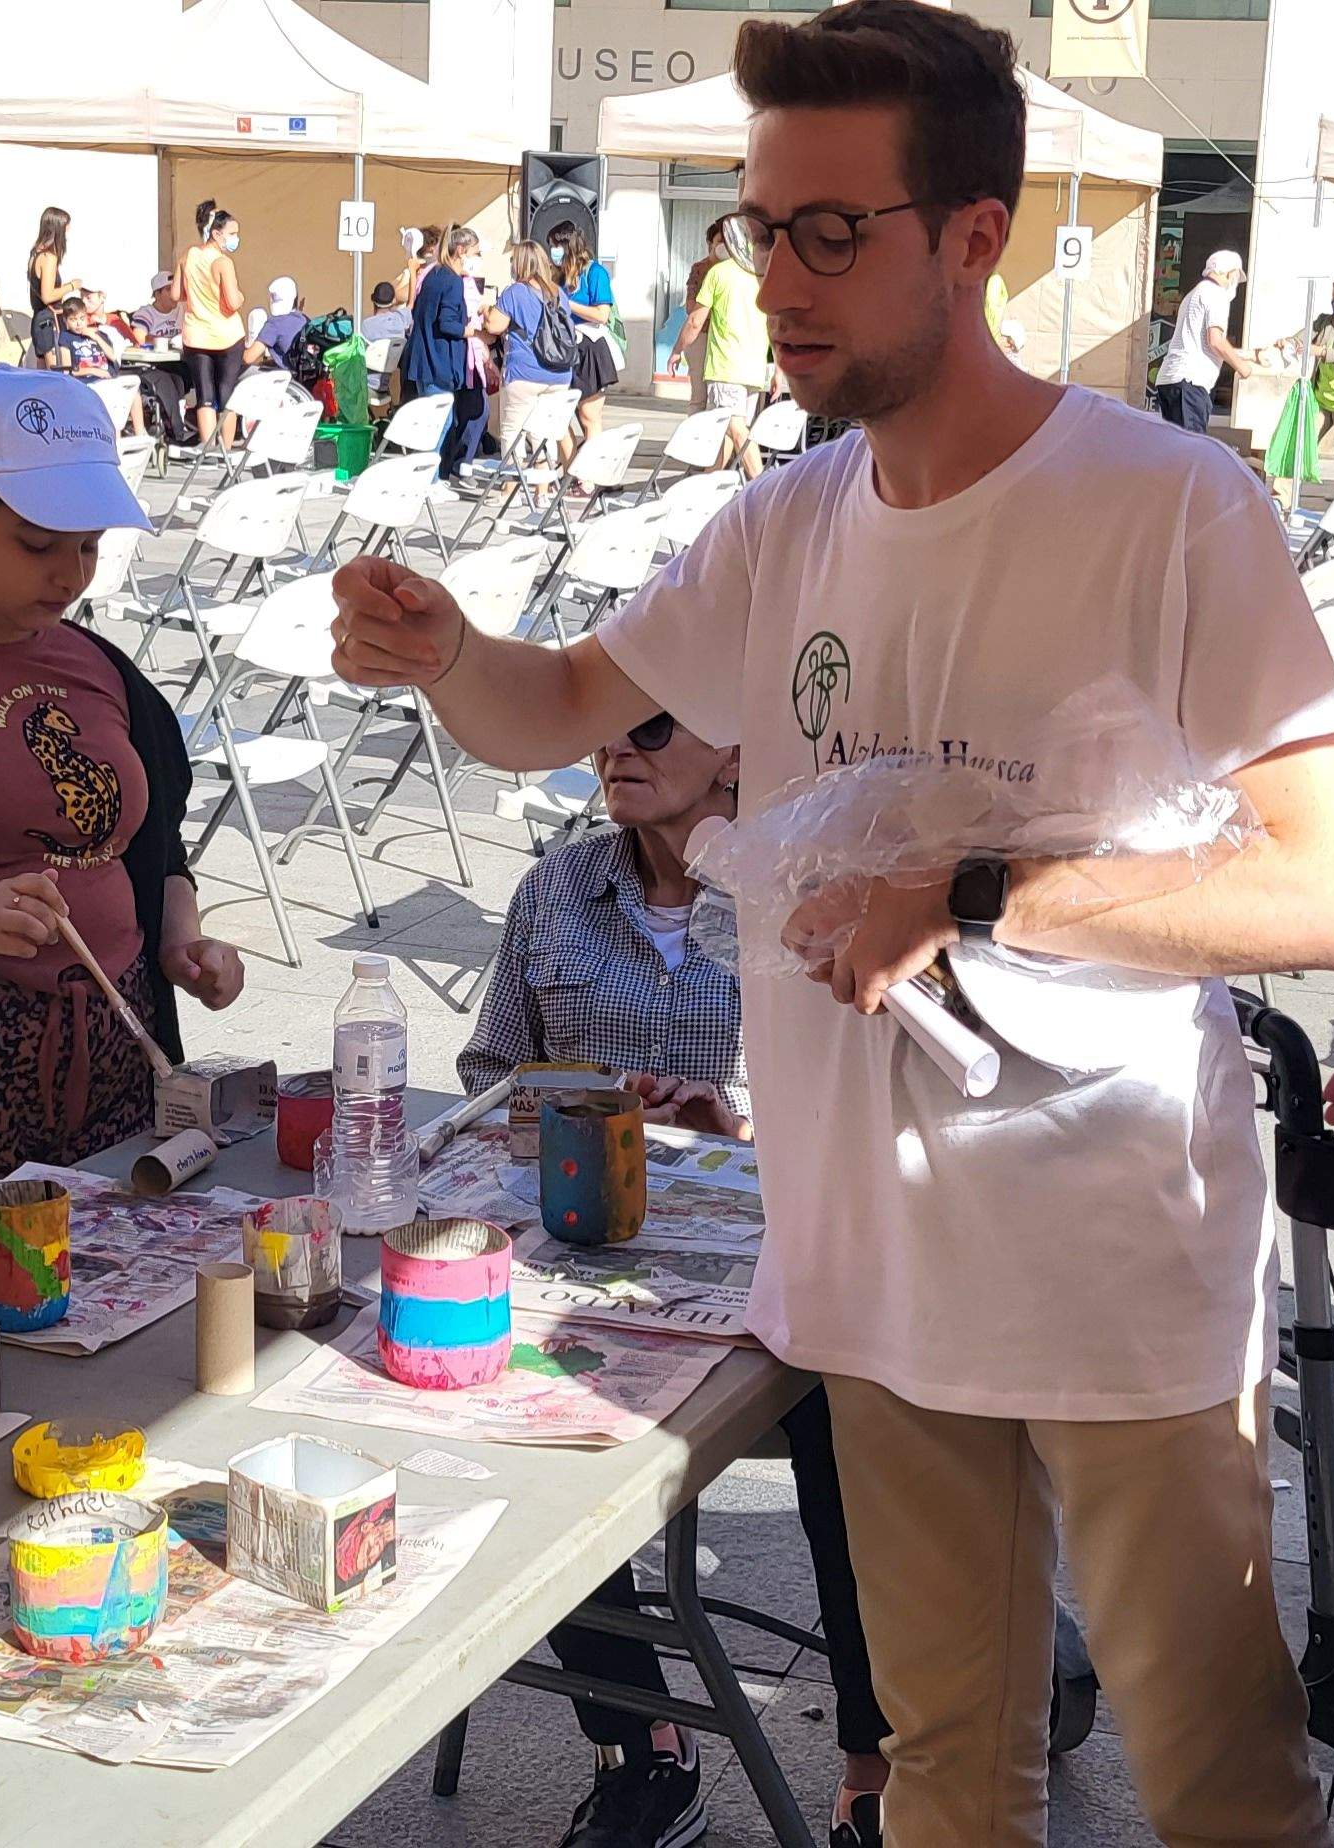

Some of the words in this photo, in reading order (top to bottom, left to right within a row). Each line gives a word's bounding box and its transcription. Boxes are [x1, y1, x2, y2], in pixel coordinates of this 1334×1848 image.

[557, 48, 695, 83] USEO
[342, 216, 369, 237] 10
[1062, 237, 1082, 268] 9
[52, 425, 94, 442] Alzheimer
[11, 684, 34, 699] ON
[36, 683, 68, 699] THE
[825, 730, 935, 769] Alzhei
[510, 1086, 529, 1097] AR
